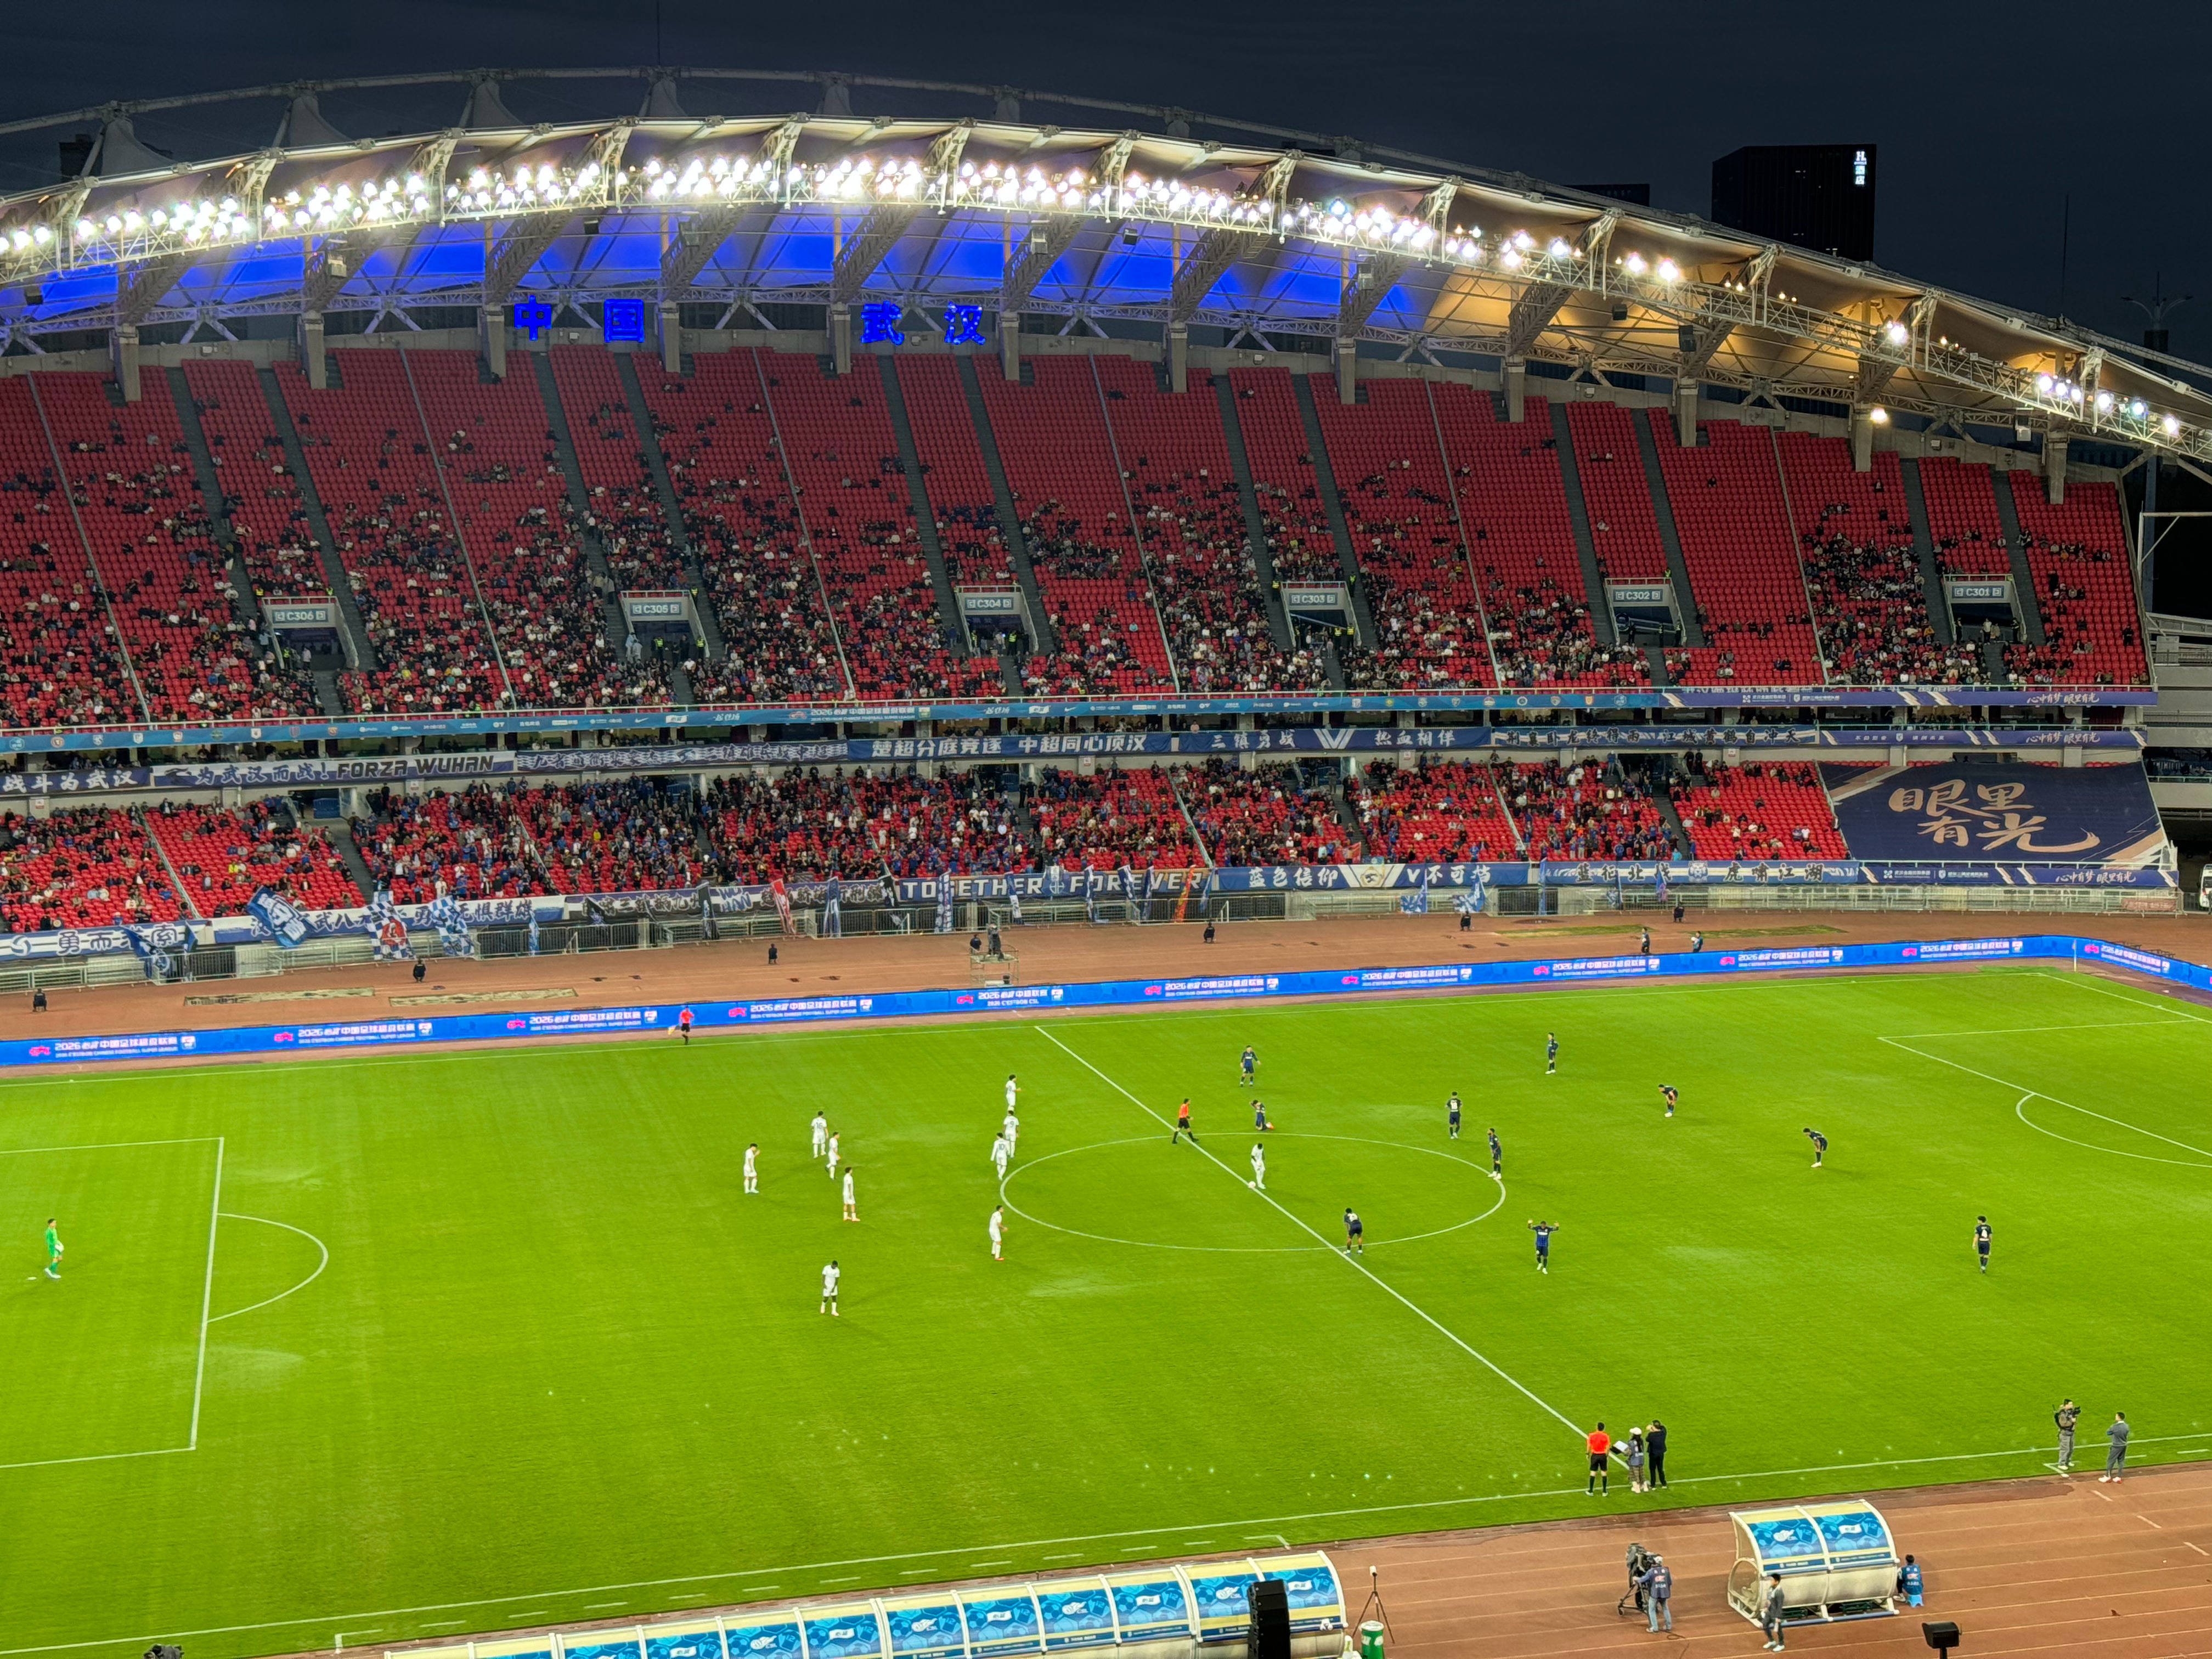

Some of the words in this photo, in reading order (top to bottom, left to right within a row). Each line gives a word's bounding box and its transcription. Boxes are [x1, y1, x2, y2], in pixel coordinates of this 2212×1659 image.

[514, 295, 645, 343] 中国
[860, 301, 986, 346] 武汉
[1301, 595, 1325, 603] C303
[1626, 591, 1650, 600] C302
[1966, 588, 1990, 596] C301
[643, 605, 668, 613] C305
[977, 599, 1002, 608] C304
[287, 611, 314, 620] C306
[1018, 735, 1147, 754] 中超同心顶汉
[1374, 730, 1455, 747] 热血相伴
[337, 759, 409, 779] FORZA
[414, 754, 494, 775] WUHAN
[3, 769, 138, 793] 战斗为武汉
[1248, 866, 1339, 888] 蓝色信仰
[1723, 861, 1825, 883] 虎啸江湖
